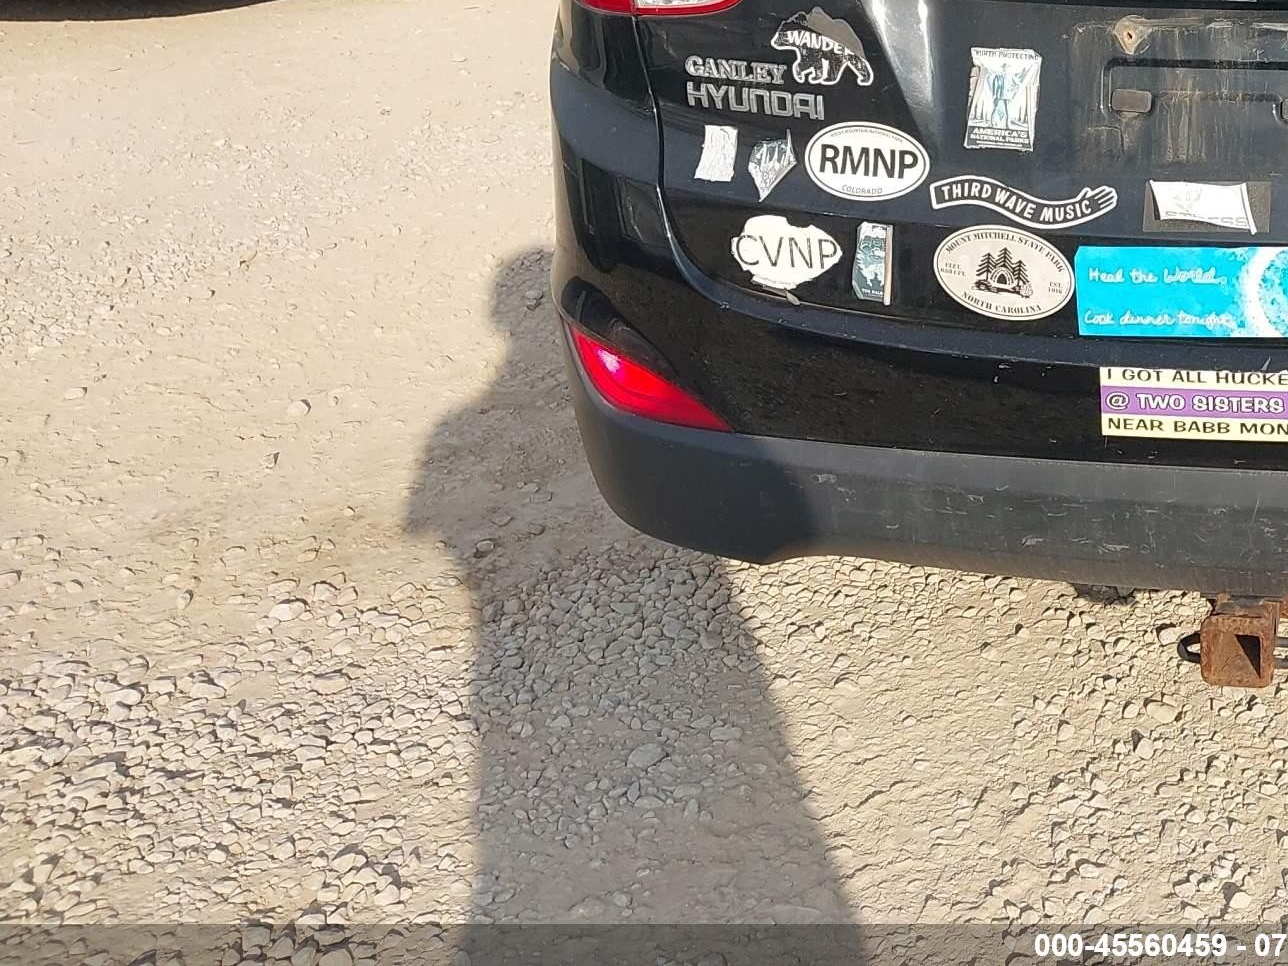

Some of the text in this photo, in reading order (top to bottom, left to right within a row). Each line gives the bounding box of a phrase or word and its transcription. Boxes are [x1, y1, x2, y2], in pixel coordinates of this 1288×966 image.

[786, 30, 854, 56] WANDER
[685, 55, 787, 84] GANLEY
[687, 81, 825, 121] HYUNDAI
[973, 127, 1029, 138] AMERICA'S
[820, 143, 918, 179] RMNP
[841, 184, 883, 194] COLORADO
[941, 182, 1092, 222] THIRD WAVE MUSIC
[735, 234, 838, 270] CVNP
[1130, 267, 1157, 284] the
[961, 291, 1042, 314] NORTH CAROLINA
[1084, 310, 1114, 325] Cook
[1107, 369, 1112, 380] I
[1121, 369, 1165, 383] GOT
[1171, 370, 1208, 384] ALL
[1105, 392, 1130, 410] @
[1135, 393, 1186, 411] TWO
[1191, 395, 1285, 414] SISTERS
[1107, 417, 1164, 432] NEAR
[1173, 421, 1231, 434] BABB
